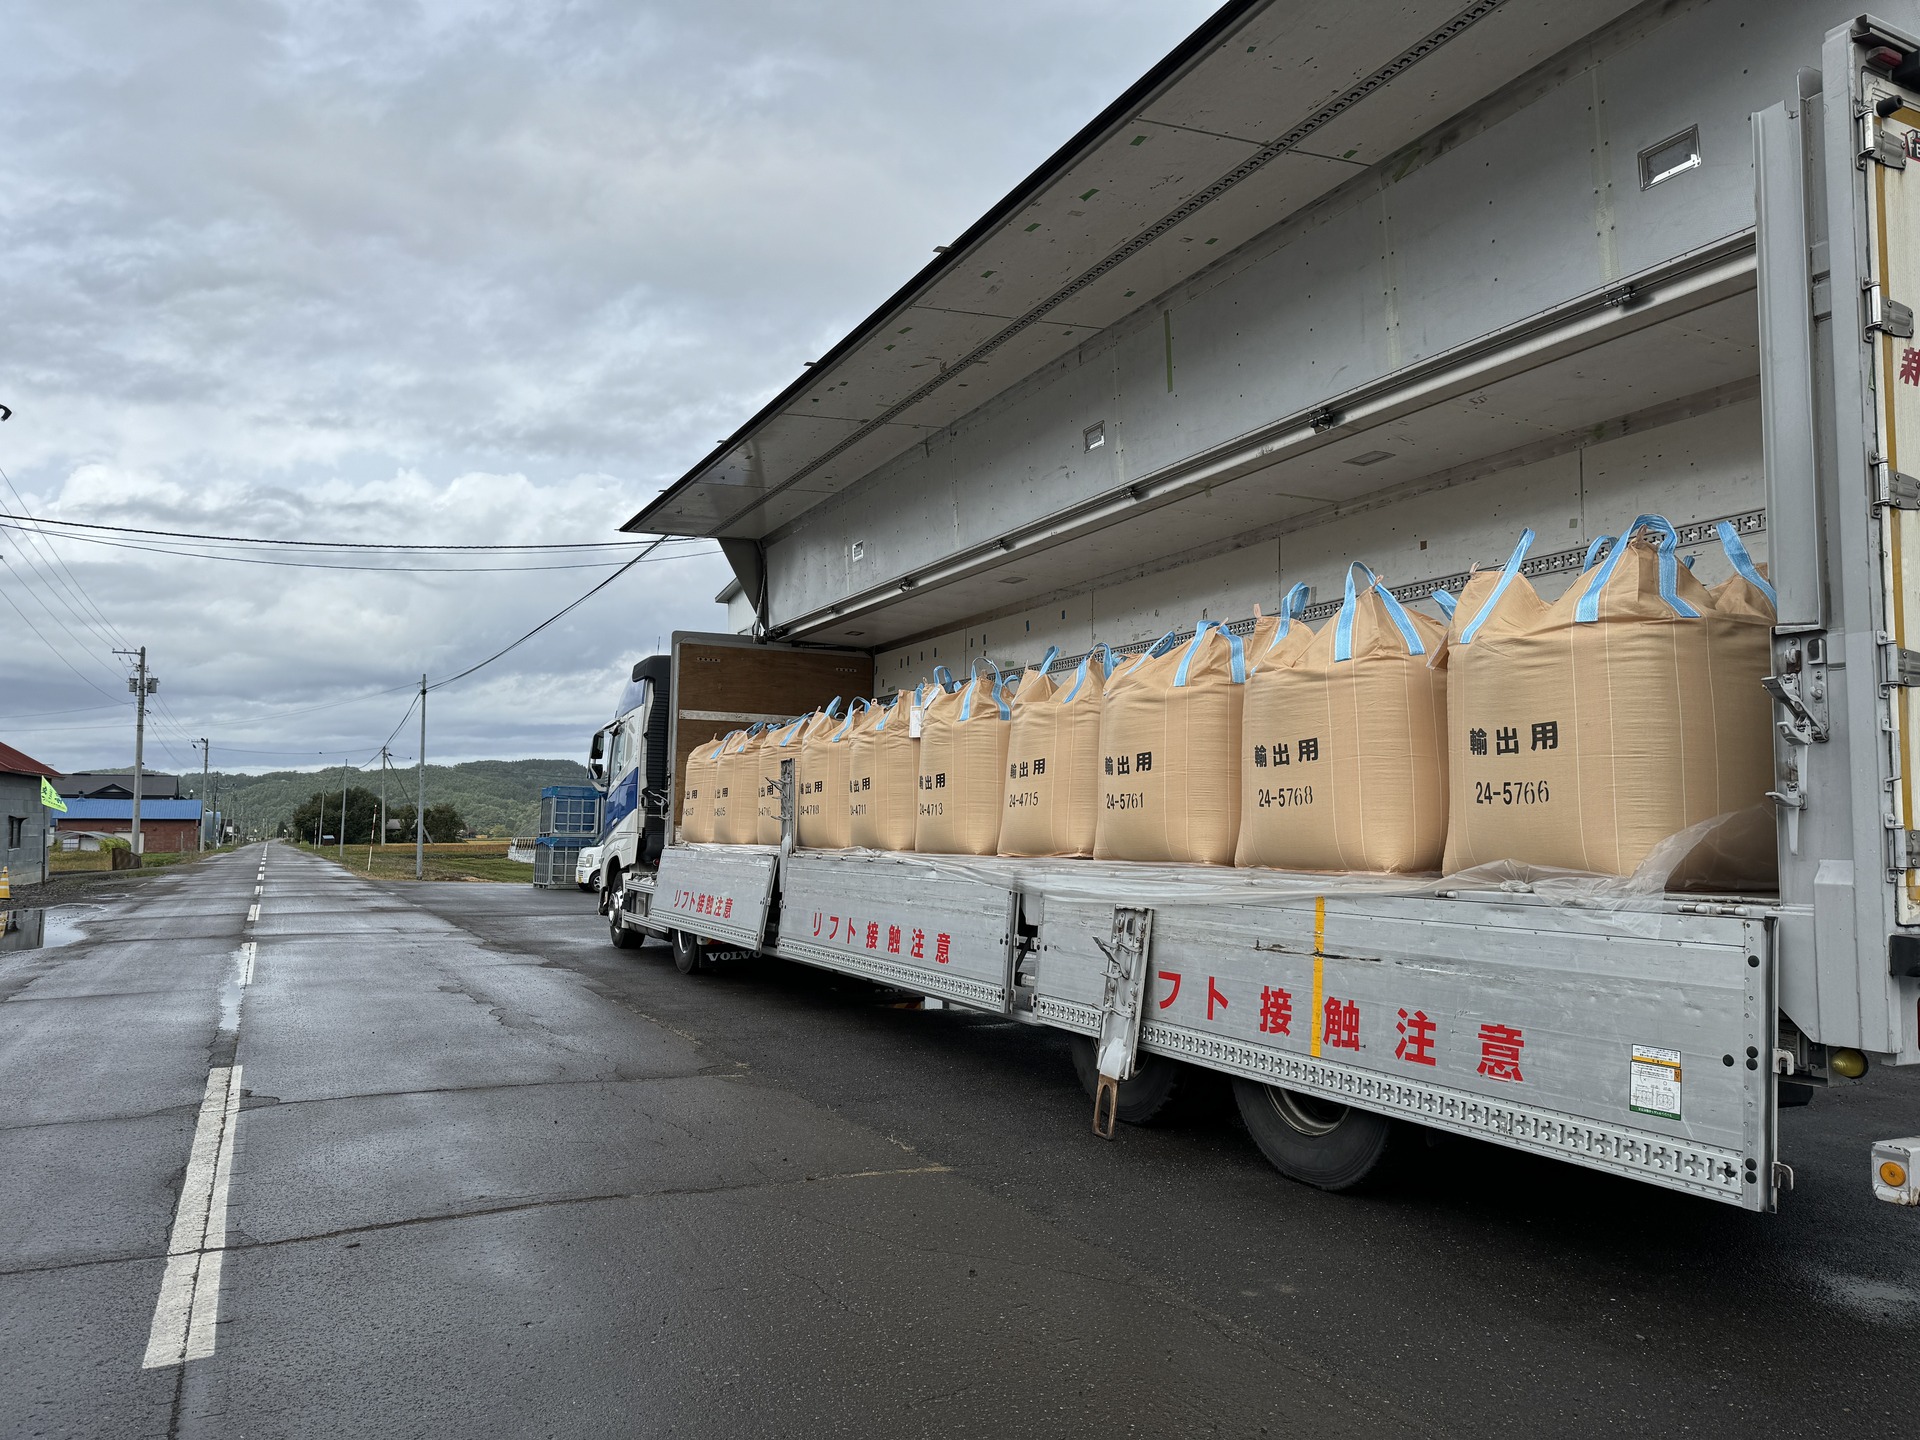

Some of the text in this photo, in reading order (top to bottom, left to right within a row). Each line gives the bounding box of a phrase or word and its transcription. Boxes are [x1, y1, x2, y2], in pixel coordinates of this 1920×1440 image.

[1469, 720, 1558, 756] 輸出用
[1105, 751, 1152, 776] 輸出用
[1254, 737, 1319, 768] 輸出用
[1009, 791, 1039, 808] 24-4715
[1106, 792, 1145, 810] 24-5761
[1258, 785, 1314, 808] 24-5768
[1475, 780, 1550, 805] 24-5766
[673, 888, 734, 919] リフト接触注意
[813, 912, 952, 965] リフト接触注意
[705, 950, 763, 962] VOLVO
[1158, 970, 1526, 1083] フト接触注意
